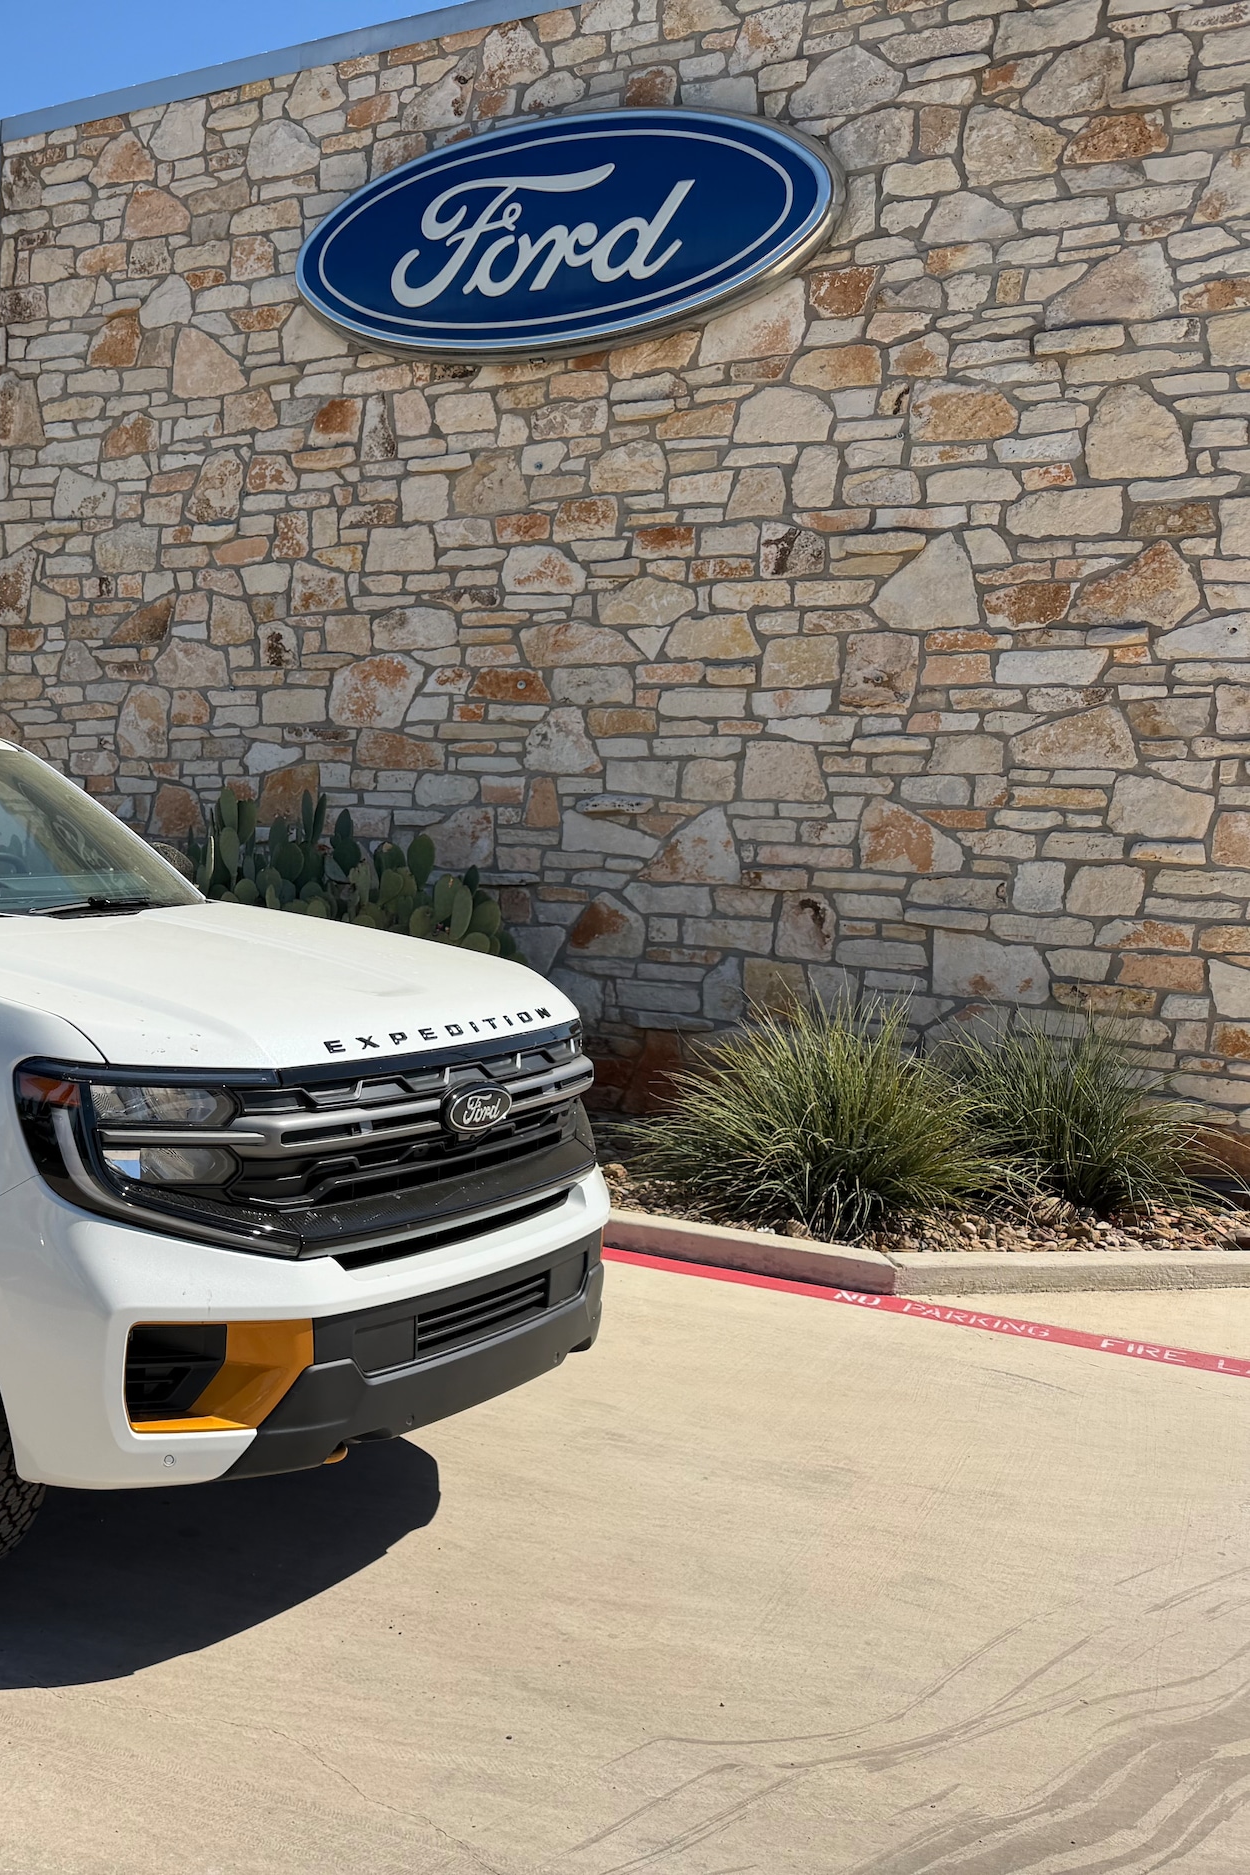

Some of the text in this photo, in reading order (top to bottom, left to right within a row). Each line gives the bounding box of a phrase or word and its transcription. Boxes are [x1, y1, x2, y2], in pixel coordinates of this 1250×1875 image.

[390, 162, 696, 308] Ford
[323, 1006, 552, 1054] EXPEDITION
[462, 1093, 501, 1126] Ford
[834, 1289, 1250, 1374] NO PARKING FIRE L
